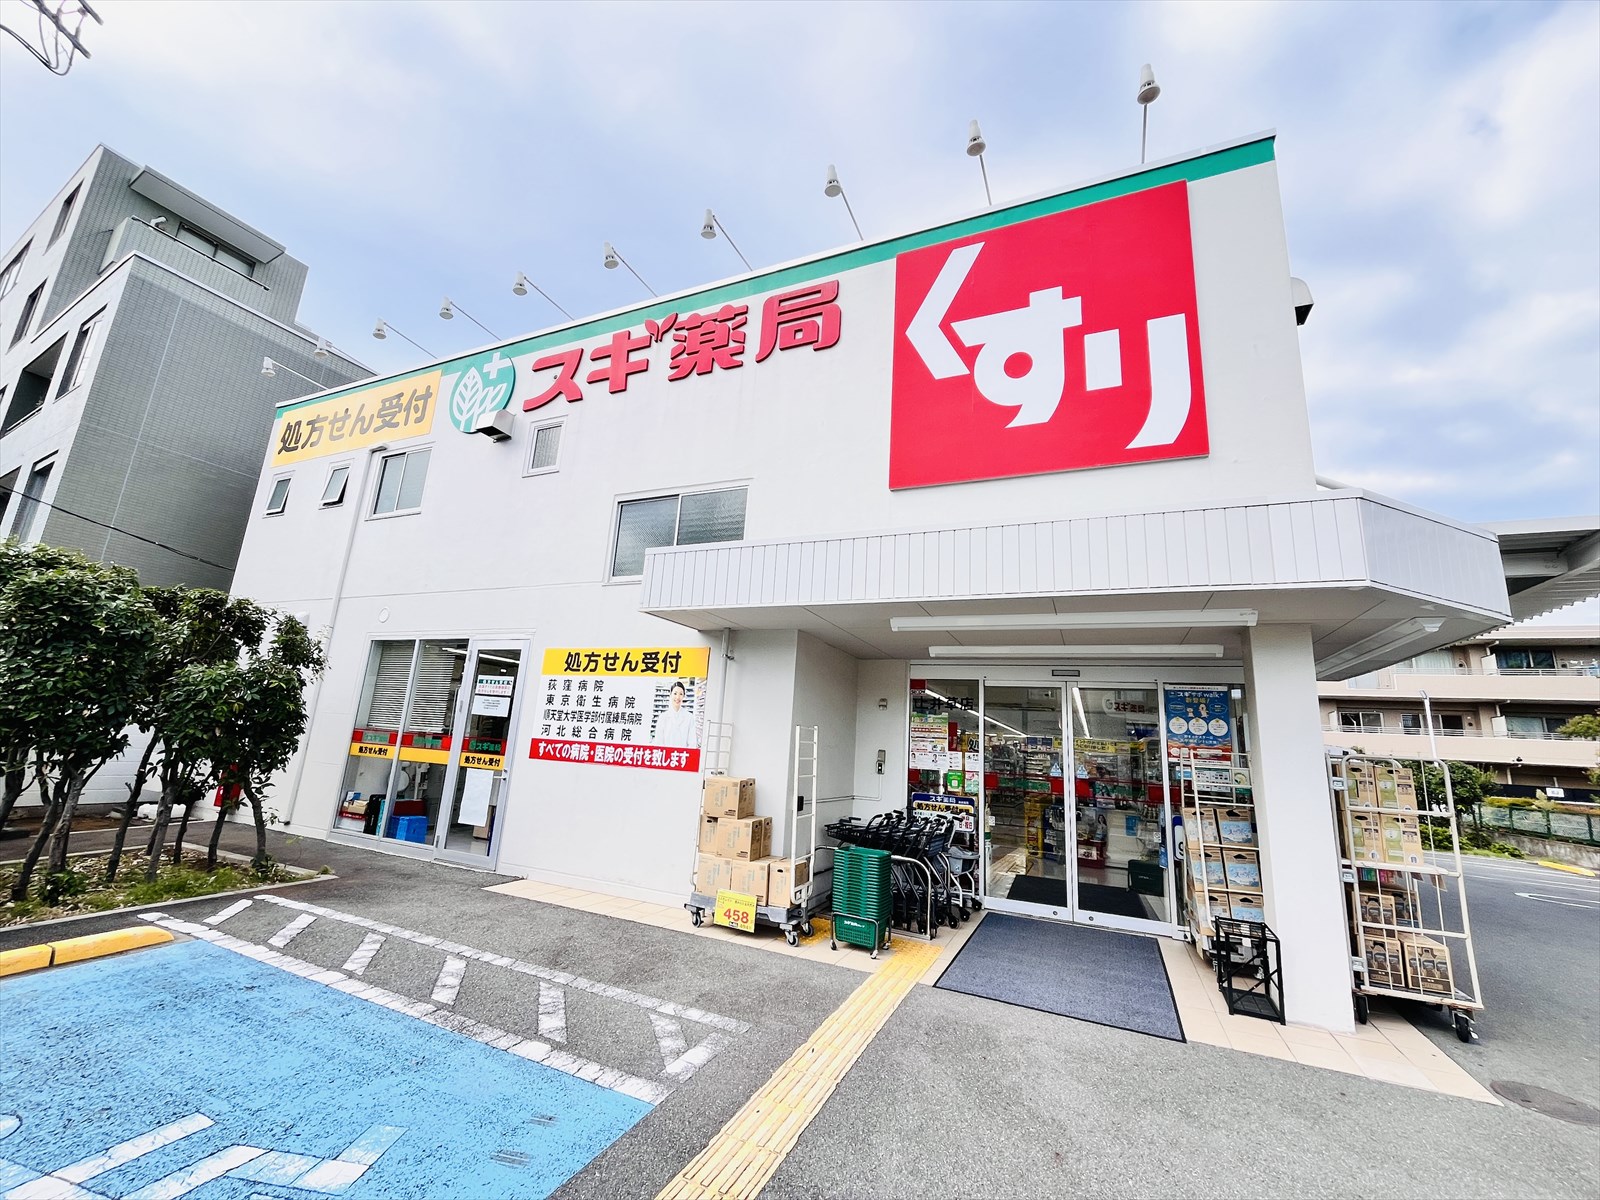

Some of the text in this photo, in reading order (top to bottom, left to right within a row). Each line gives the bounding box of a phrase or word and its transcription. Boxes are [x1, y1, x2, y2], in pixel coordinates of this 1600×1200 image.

[522, 279, 843, 412] スギ薬局
[904, 241, 1192, 450] くすり
[276, 385, 434, 456] 処方せん受付
[564, 651, 682, 674] 処方せん受付
[547, 679, 604, 692] 荻窪病院
[545, 694, 636, 709] 東京衛生病院
[543, 709, 643, 726] 順天堂大学医学部付属練馬病院
[541, 724, 632, 742] 河北総合病院
[358, 745, 388, 756] 処方せん受付
[538, 741, 690, 768] すべての病院・医院の受付を致します
[464, 755, 501, 767] 処方せん受付
[723, 907, 749, 924] 458
